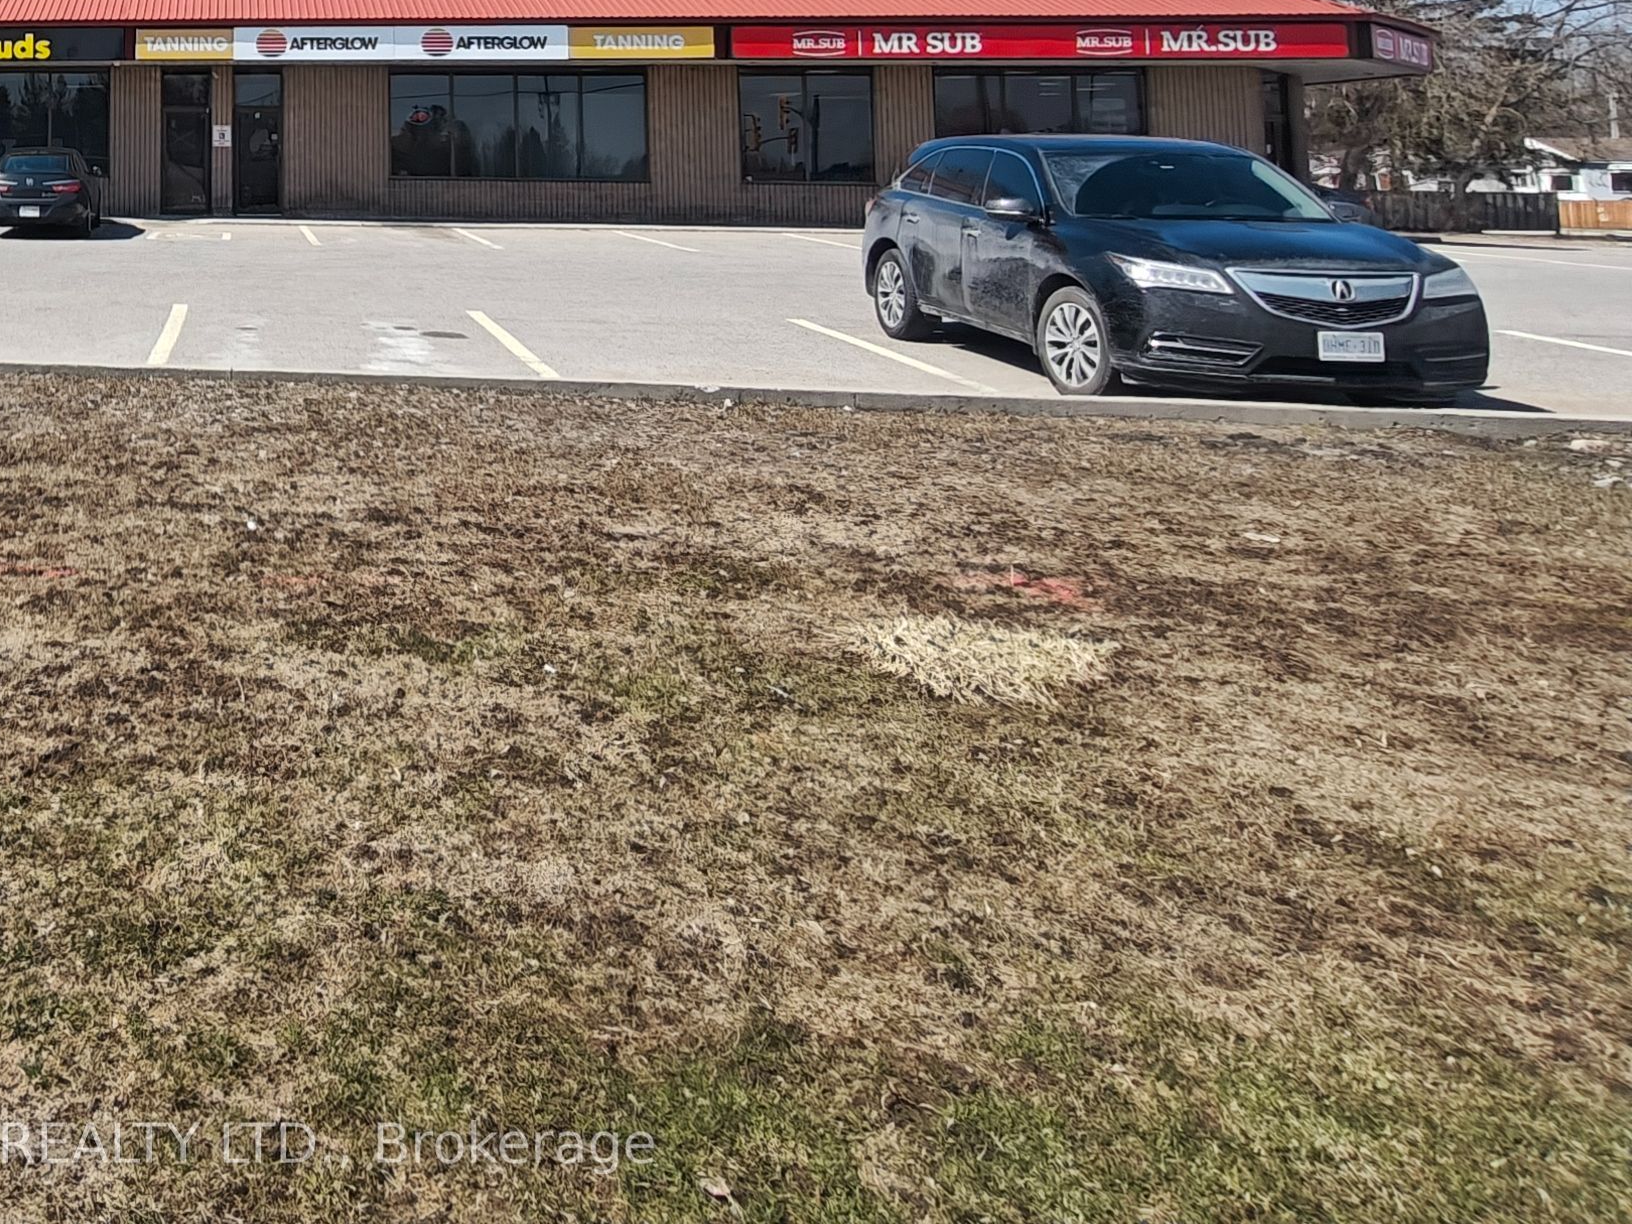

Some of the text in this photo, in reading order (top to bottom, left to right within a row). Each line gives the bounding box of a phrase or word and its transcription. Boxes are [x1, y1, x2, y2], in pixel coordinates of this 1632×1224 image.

[144, 36, 229, 53] TANNING
[289, 36, 379, 51] AFTERGLOW
[455, 35, 548, 50] AFTERGLOW
[593, 34, 685, 50] TANNING
[926, 32, 983, 54] SUB
[1160, 30, 1277, 52] MR.SUB
